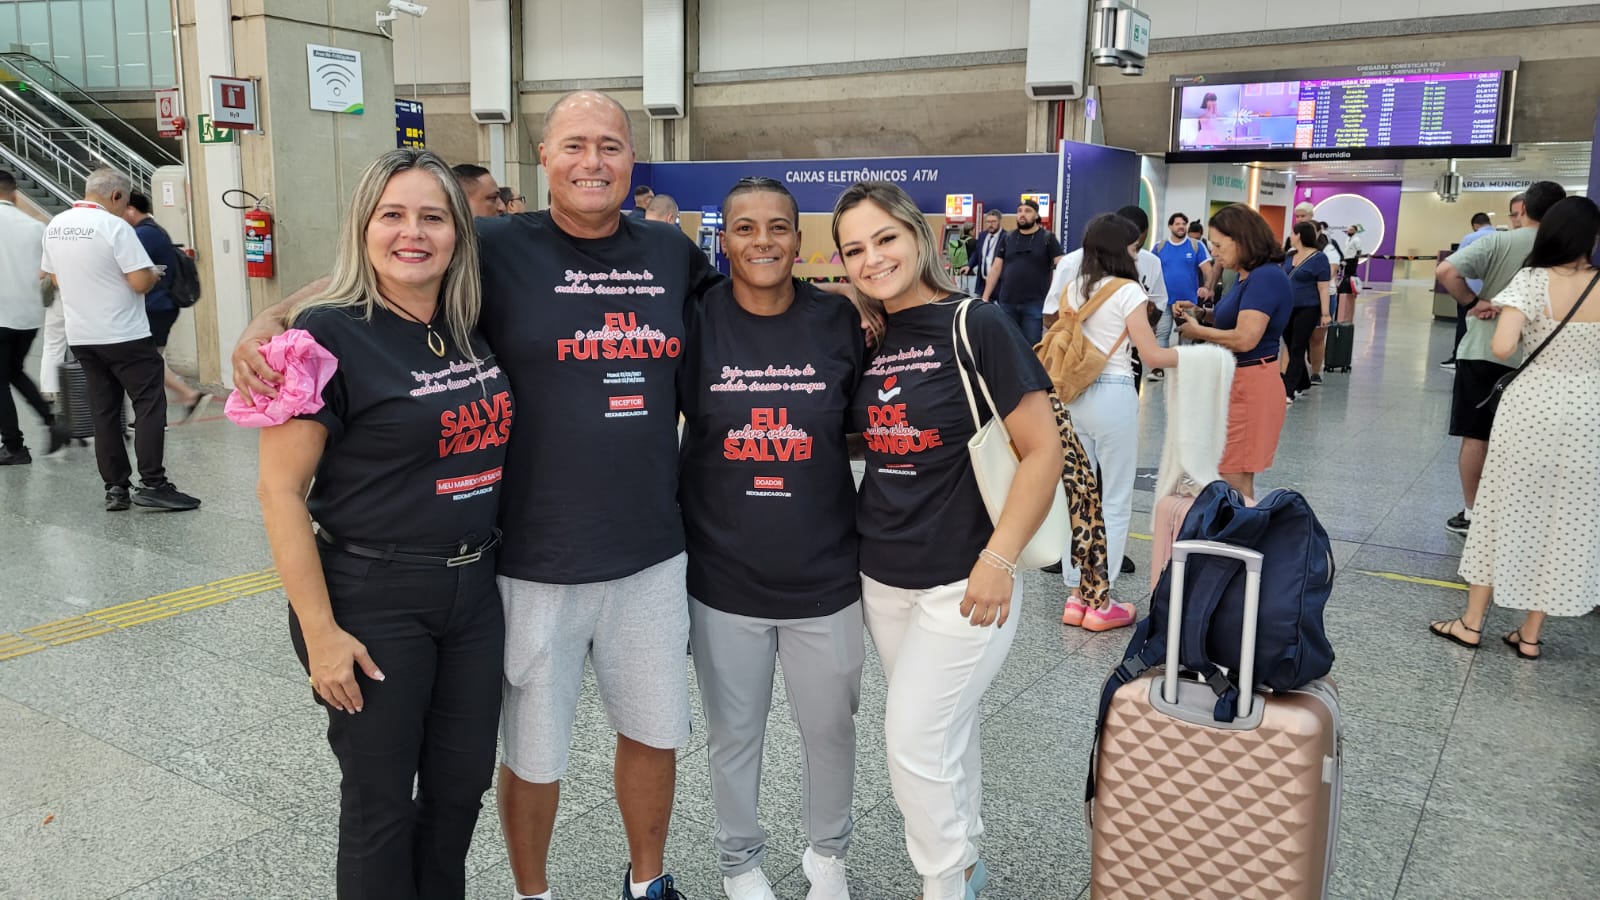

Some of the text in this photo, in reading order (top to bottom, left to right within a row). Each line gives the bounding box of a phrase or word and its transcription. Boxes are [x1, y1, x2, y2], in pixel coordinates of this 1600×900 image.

[786, 167, 938, 182] CAIXAS ELETRÔNICOS ATM
[64, 227, 94, 236] GROUP
[604, 312, 637, 332] EU
[586, 325, 625, 340] salve
[558, 337, 681, 361] FUI SALVO
[764, 364, 801, 377] doador
[790, 382, 826, 394] sangue
[440, 390, 512, 438] SALVE
[751, 408, 788, 432] EU
[868, 403, 908, 428] DOE
[438, 418, 512, 458] VIDAS
[728, 424, 766, 440] salve
[862, 428, 944, 456] SANGUE
[438, 482, 454, 490] MEU
